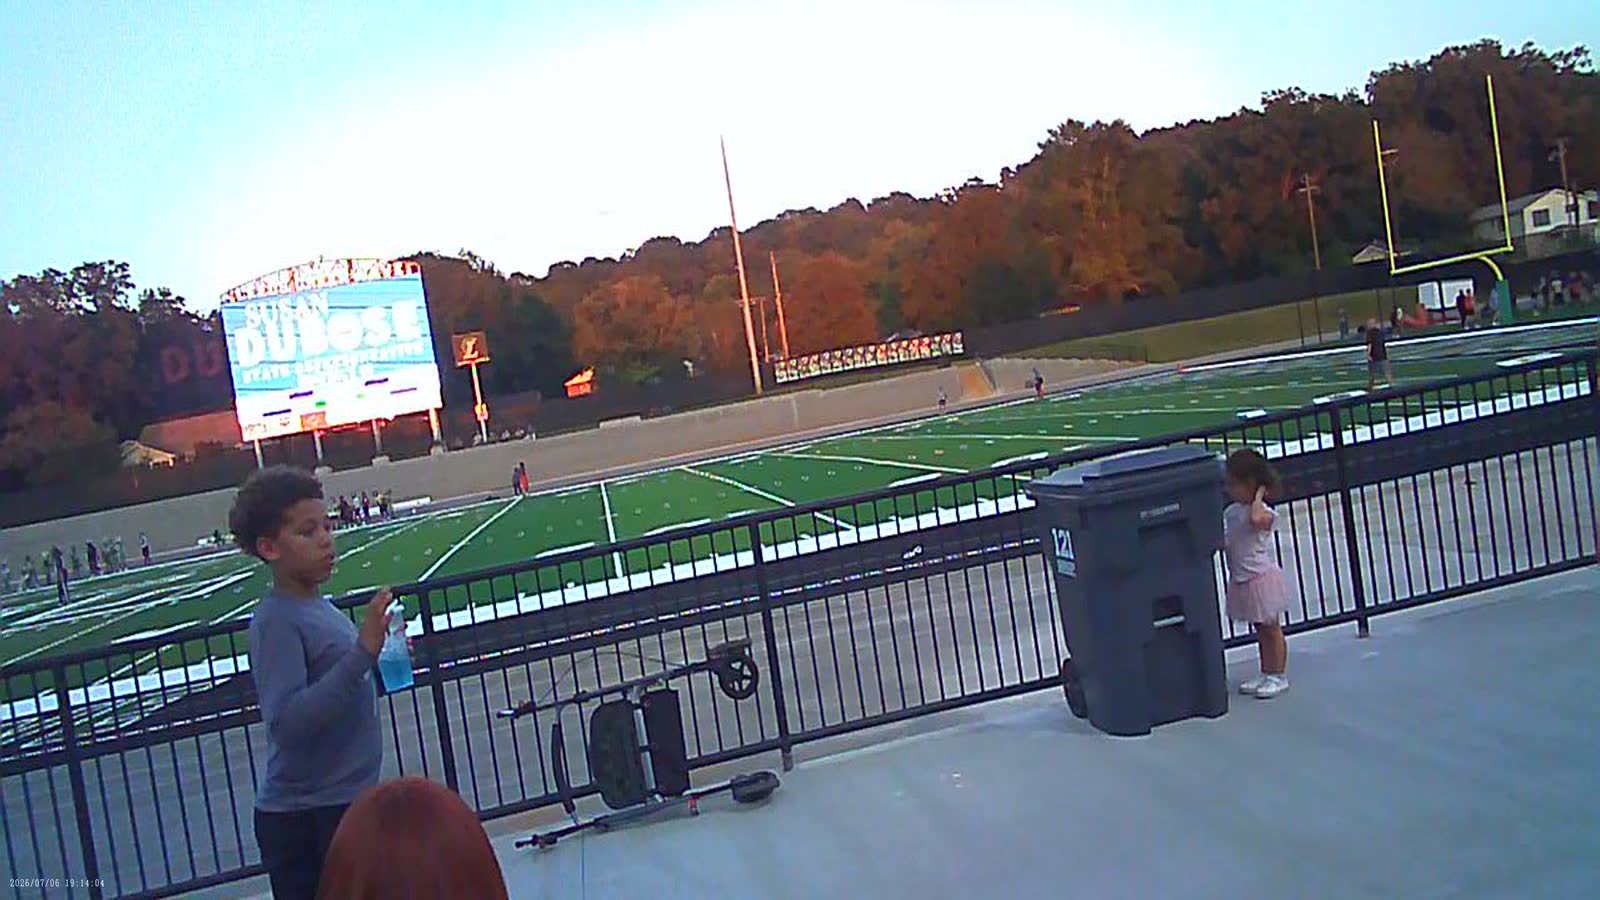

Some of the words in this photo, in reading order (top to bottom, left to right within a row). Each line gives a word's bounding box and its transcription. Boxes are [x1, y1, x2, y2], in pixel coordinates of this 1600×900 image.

[245, 292, 328, 328] SUSAN
[234, 300, 421, 367] DUBOSE
[1052, 528, 1075, 559] 121
